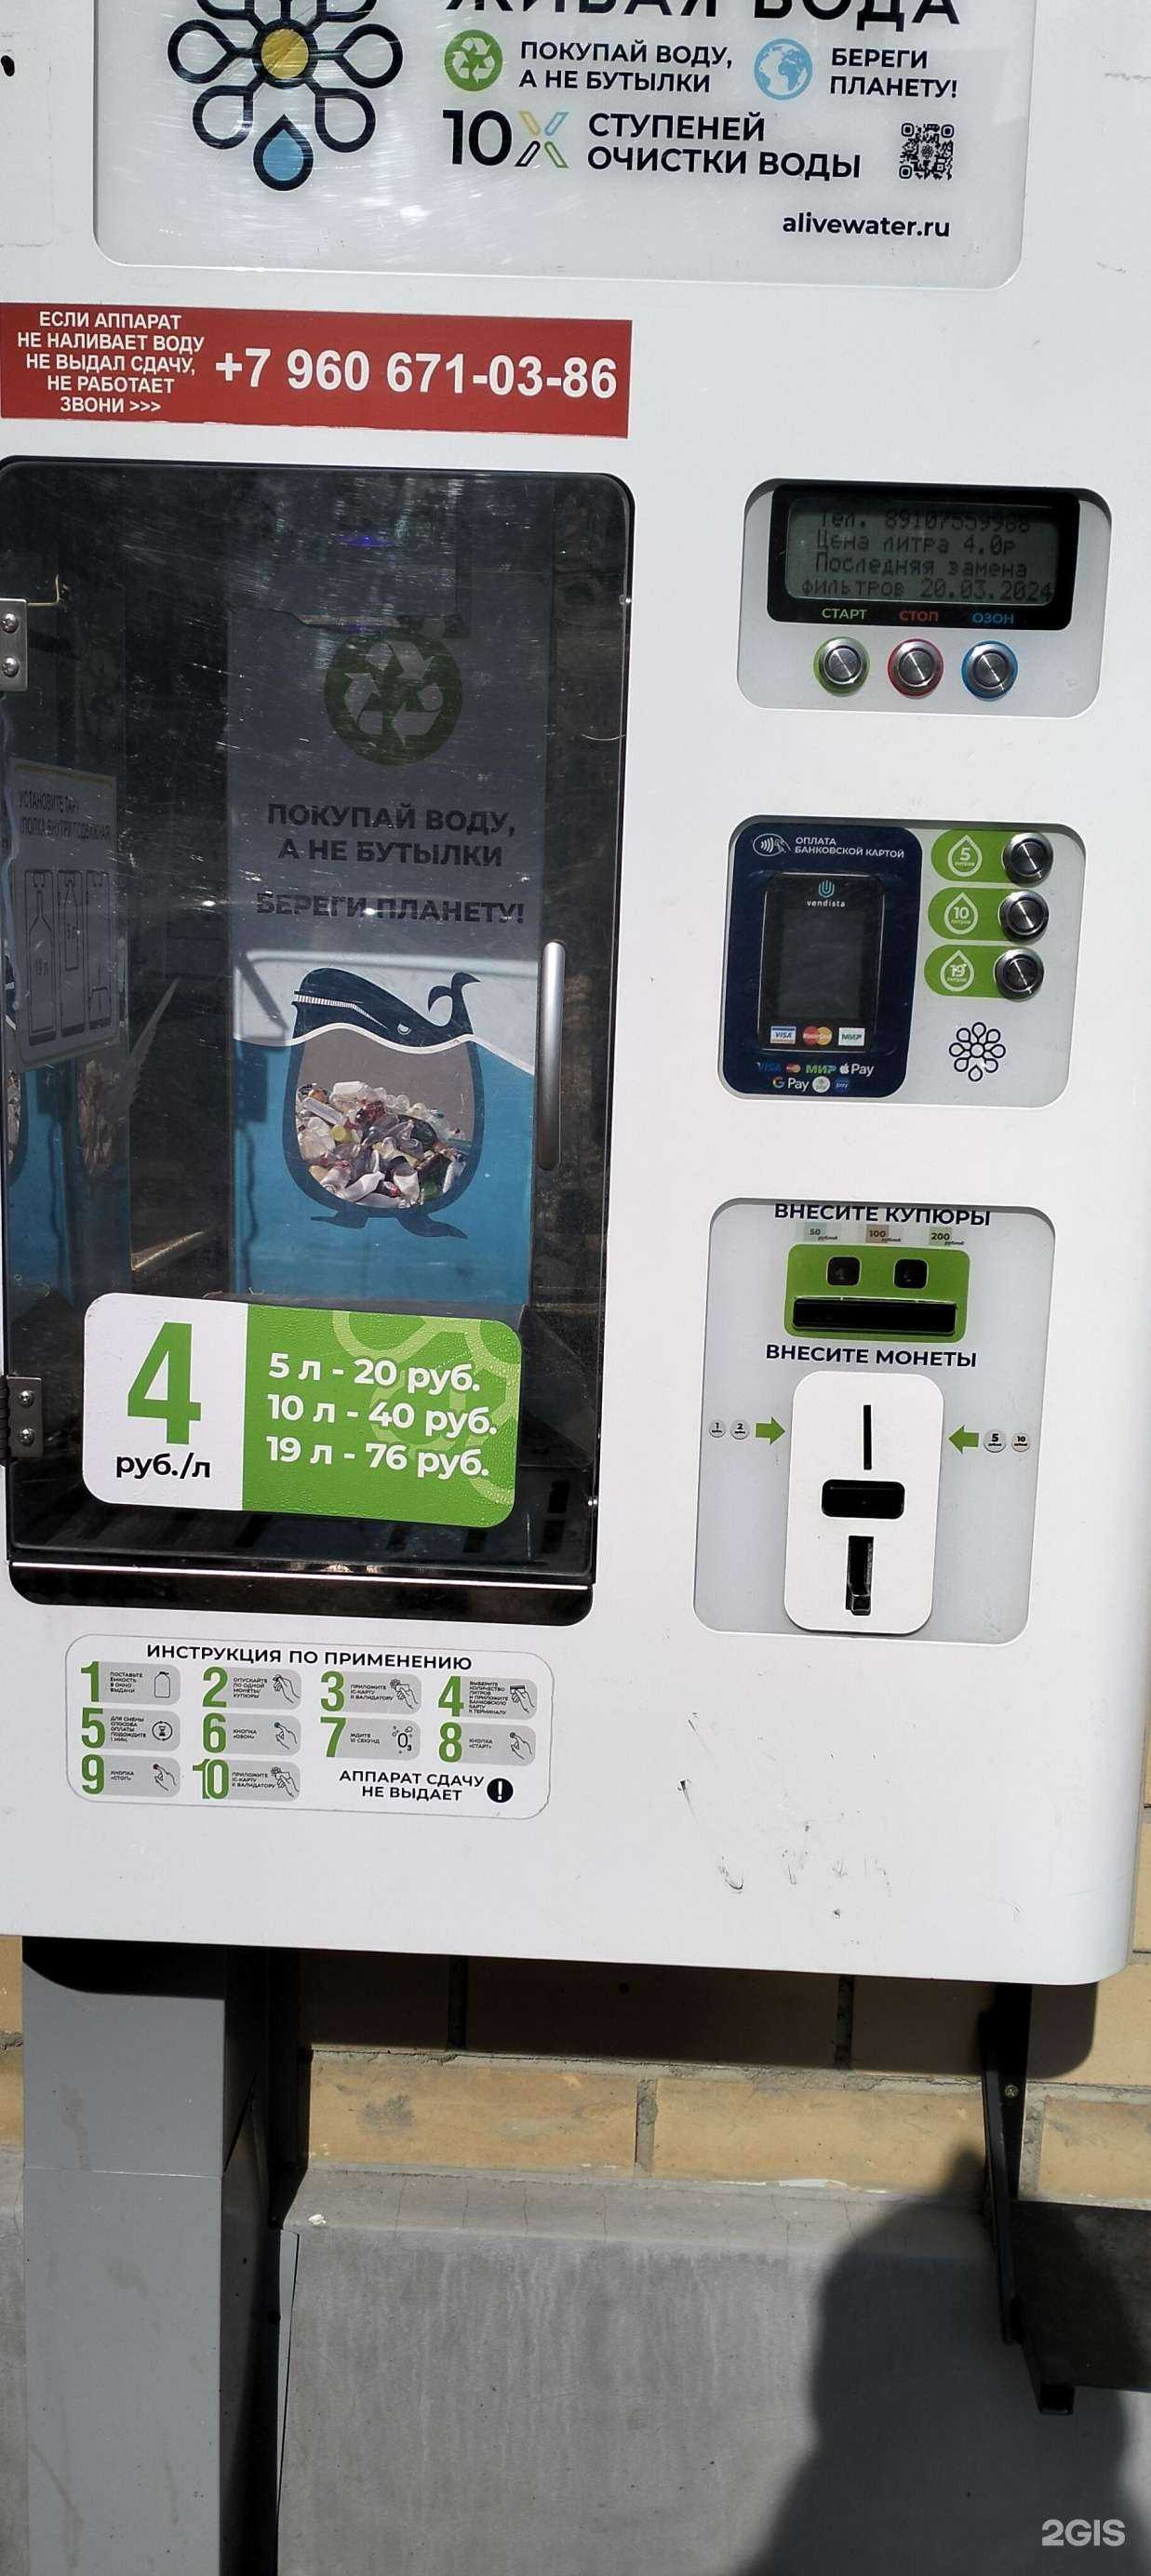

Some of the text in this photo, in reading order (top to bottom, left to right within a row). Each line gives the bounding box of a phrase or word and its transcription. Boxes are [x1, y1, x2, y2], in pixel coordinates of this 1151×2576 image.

[519, 39, 732, 70] ПОКУПАЙ ВОДУ,
[831, 47, 928, 70] БЕРЕГИ
[517, 69, 710, 93] А НЕ БУТЫЛКИ
[829, 75, 957, 99] ПЛАНЕТУ!
[588, 111, 765, 142] СТУПЕНЕЙ
[587, 145, 862, 182] ОЧИСТКИ ВОДЫ
[783, 211, 950, 237] alivewater.ru
[39, 311, 182, 329] ЕСЛИ АППАРАТ
[18, 331, 205, 356] НЕ НАЛИВАЕТ ВОДУ
[26, 353, 195, 376] НЕ ВЫДАЛ СДАЧУ,
[215, 347, 618, 399] +7 960 671-03-86
[47, 374, 175, 394] НЕ РАБОТАЕТ
[60, 396, 125, 413] ЗВОНИ
[816, 530, 869, 551] Цена
[883, 536, 950, 554] литра
[814, 552, 1028, 578] Последняя замена
[919, 578, 1056, 602] 20.03.2024
[821, 608, 868, 621] СТАРТ
[898, 610, 939, 623] СТОП
[971, 612, 1014, 624] ОЗОН
[267, 802, 516, 837] ПОКУПАЙ ВОДУ,
[278, 838, 502, 867] А НЕ БУТЫЛКИ
[795, 837, 837, 847] ОПЛАТА
[795, 845, 905, 859] БАНКОВСКОЙ КАРТОЙ
[959, 848, 971, 861] 5
[256, 892, 526, 924] БЕРЕГИ ПЛАНЕТУ!
[807, 897, 846, 907] vendista
[953, 906, 970, 919] 10
[950, 963, 967, 977] 19
[805, 1064, 837, 1074] МИР
[850, 1063, 875, 1077] Pay
[787, 1077, 810, 1093] Pay
[774, 1202, 991, 1227] ВНЕСИТЕ КУПЮРЫ
[810, 1228, 821, 1236] 50
[869, 1229, 887, 1238] 100
[930, 1232, 950, 1241] 200
[766, 1344, 977, 1368] ВНЕСИТЕ МОНЕТЫ
[127, 1322, 202, 1445] 4
[268, 1352, 290, 1379] 5
[298, 1360, 321, 1381] л
[353, 1358, 397, 1387] 20
[407, 1363, 480, 1396] руб.
[267, 1393, 304, 1421] 10
[312, 1402, 336, 1424] л
[368, 1401, 415, 1429] 40
[425, 1406, 498, 1439] руб.
[991, 1433, 999, 1442] 5
[115, 1452, 211, 1480] руб./л
[266, 1435, 301, 1463] 19
[309, 1444, 332, 1465] л
[365, 1442, 408, 1470] 76
[417, 1448, 489, 1481] руб.
[147, 1644, 472, 1670] ИНСТРУКЦИЯ ПО ПРИМЕНЕНИЮ
[81, 1660, 99, 1702] 1
[202, 1666, 228, 1708] 2
[320, 1670, 344, 1711] 3
[437, 1675, 464, 1717] 4
[81, 1707, 105, 1749] 5
[203, 1712, 227, 1753] 6
[320, 1716, 346, 1758] 7
[438, 1722, 462, 1763] 8
[81, 1754, 104, 1794] 9
[192, 1759, 230, 1799] 10
[339, 1770, 485, 1789] АППАРАТ СДАЧУ
[362, 1785, 462, 1802] НЕ ВЫДАЕТ
